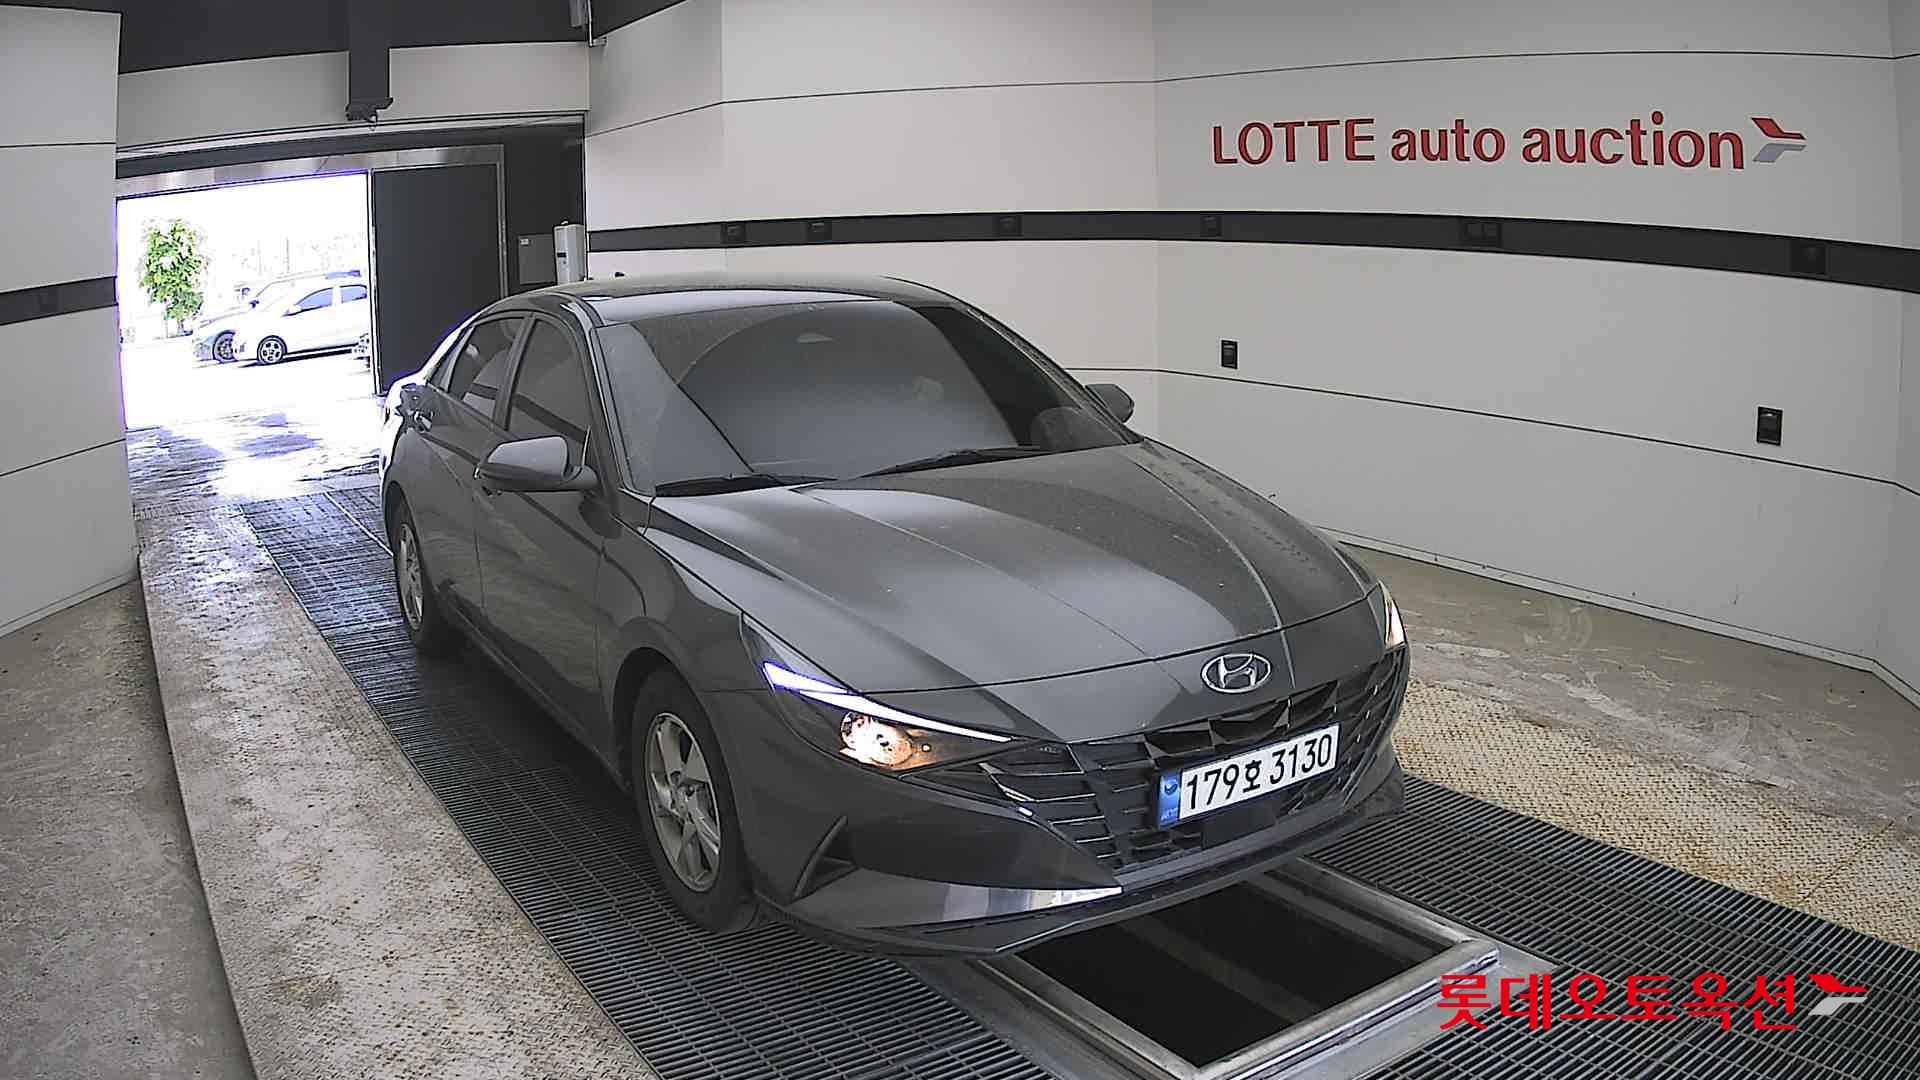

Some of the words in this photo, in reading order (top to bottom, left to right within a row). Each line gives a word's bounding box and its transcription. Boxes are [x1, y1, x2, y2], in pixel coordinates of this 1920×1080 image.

[1212, 117, 1376, 165] LOTTE
[1391, 118, 1505, 164] auto
[1522, 111, 1745, 170] auction
[1187, 759, 1262, 809] 179호
[1269, 734, 1332, 785] 3130
